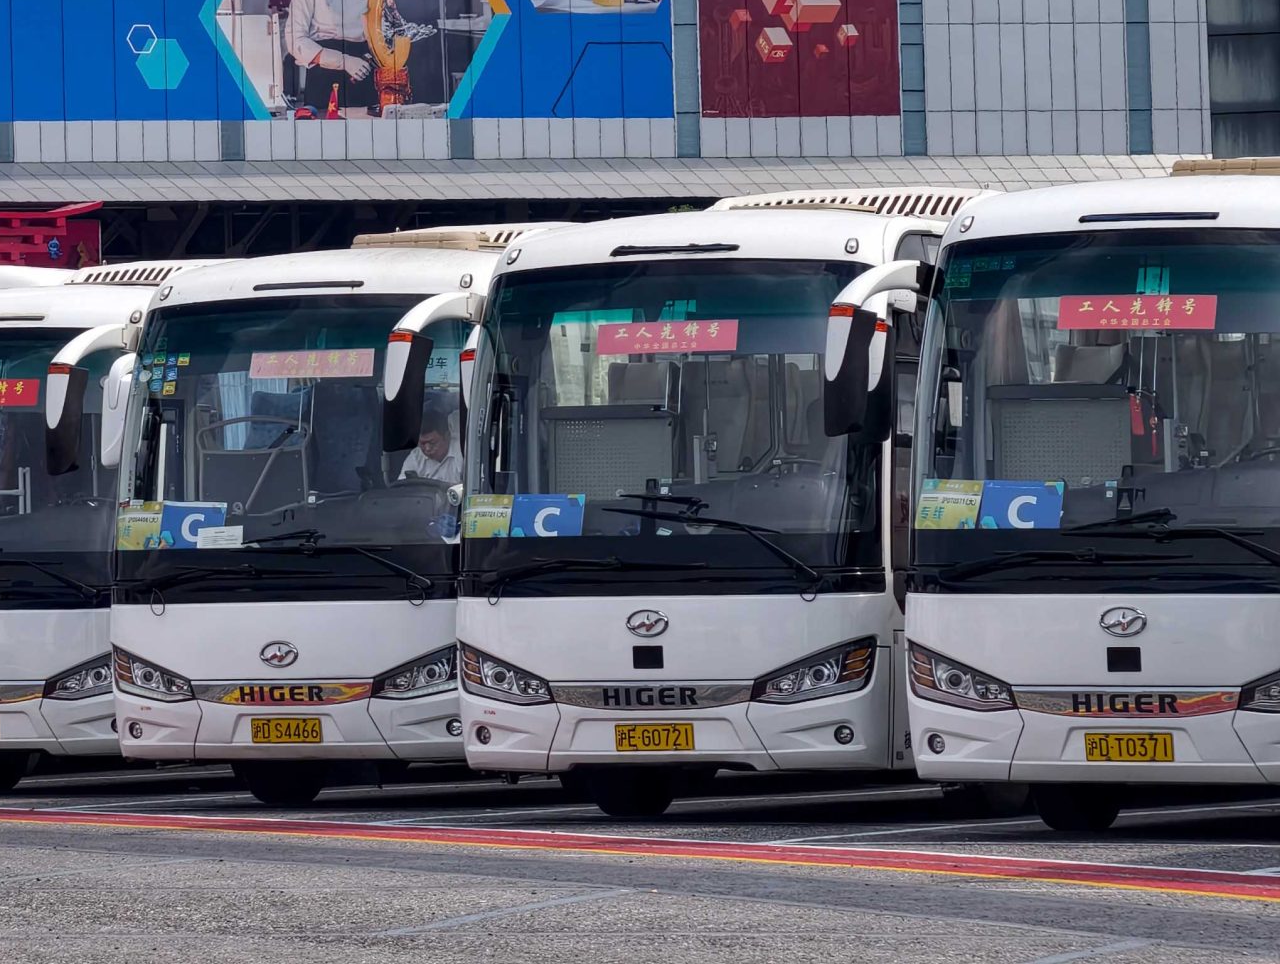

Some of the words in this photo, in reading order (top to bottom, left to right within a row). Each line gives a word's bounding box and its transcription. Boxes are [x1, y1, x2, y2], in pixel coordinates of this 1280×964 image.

[1078, 297, 1197, 315] 工人先锋号
[614, 321, 720, 339] 工人先锋号
[266, 351, 359, 366] 工人先锋号
[533, 506, 561, 537] C
[1007, 495, 1038, 529] C
[181, 513, 205, 543] C
[238, 685, 324, 703] HIGER
[602, 687, 699, 707] HIGER
[1071, 693, 1179, 714] HIGER
